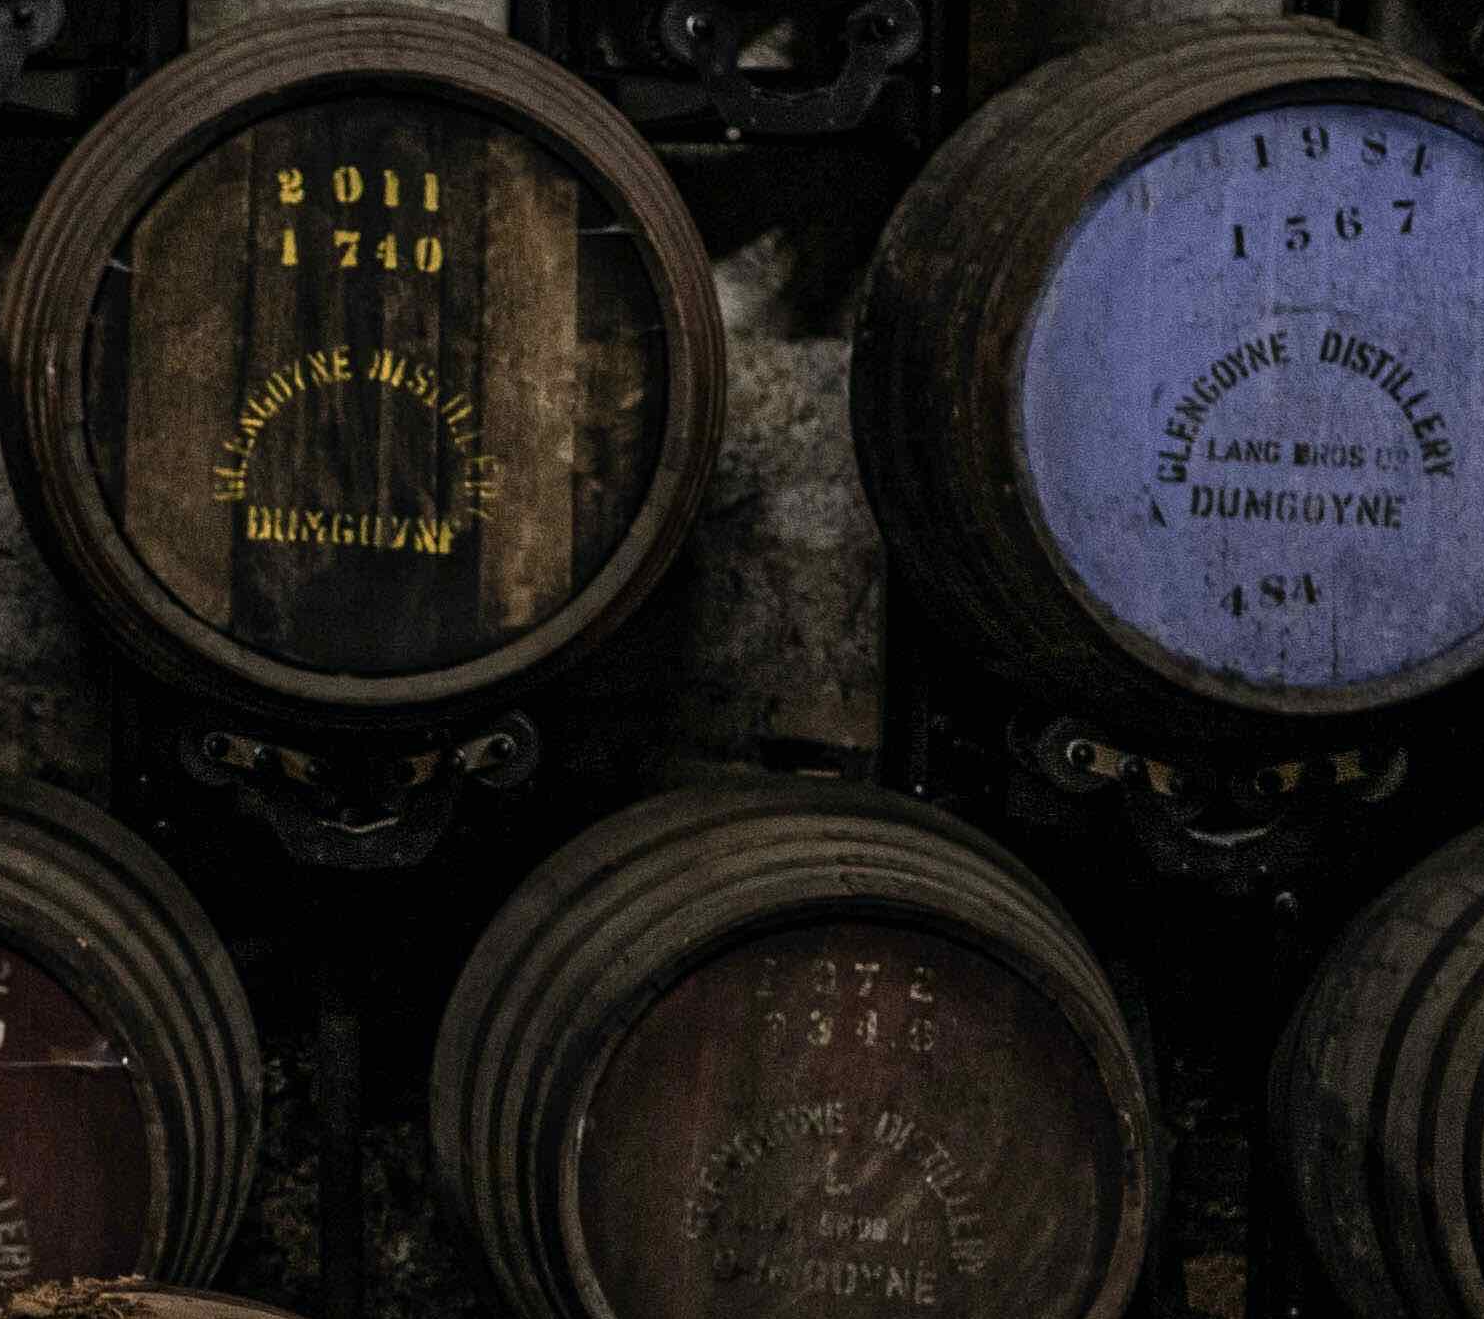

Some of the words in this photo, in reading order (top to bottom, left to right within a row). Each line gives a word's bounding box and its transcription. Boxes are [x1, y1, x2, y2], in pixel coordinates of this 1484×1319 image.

[275, 165, 441, 213] 2011
[281, 226, 445, 274] 1740
[1232, 199, 1417, 260] 1567
[213, 344, 354, 504] GLENGOYNE
[1158, 330, 1289, 485] GLENGOYNE
[1319, 329, 1457, 481] DISTILLERY
[1205, 438, 1281, 467] LANG
[1292, 440, 1364, 469] BROS
[1190, 484, 1404, 530] DUMGOYNE
